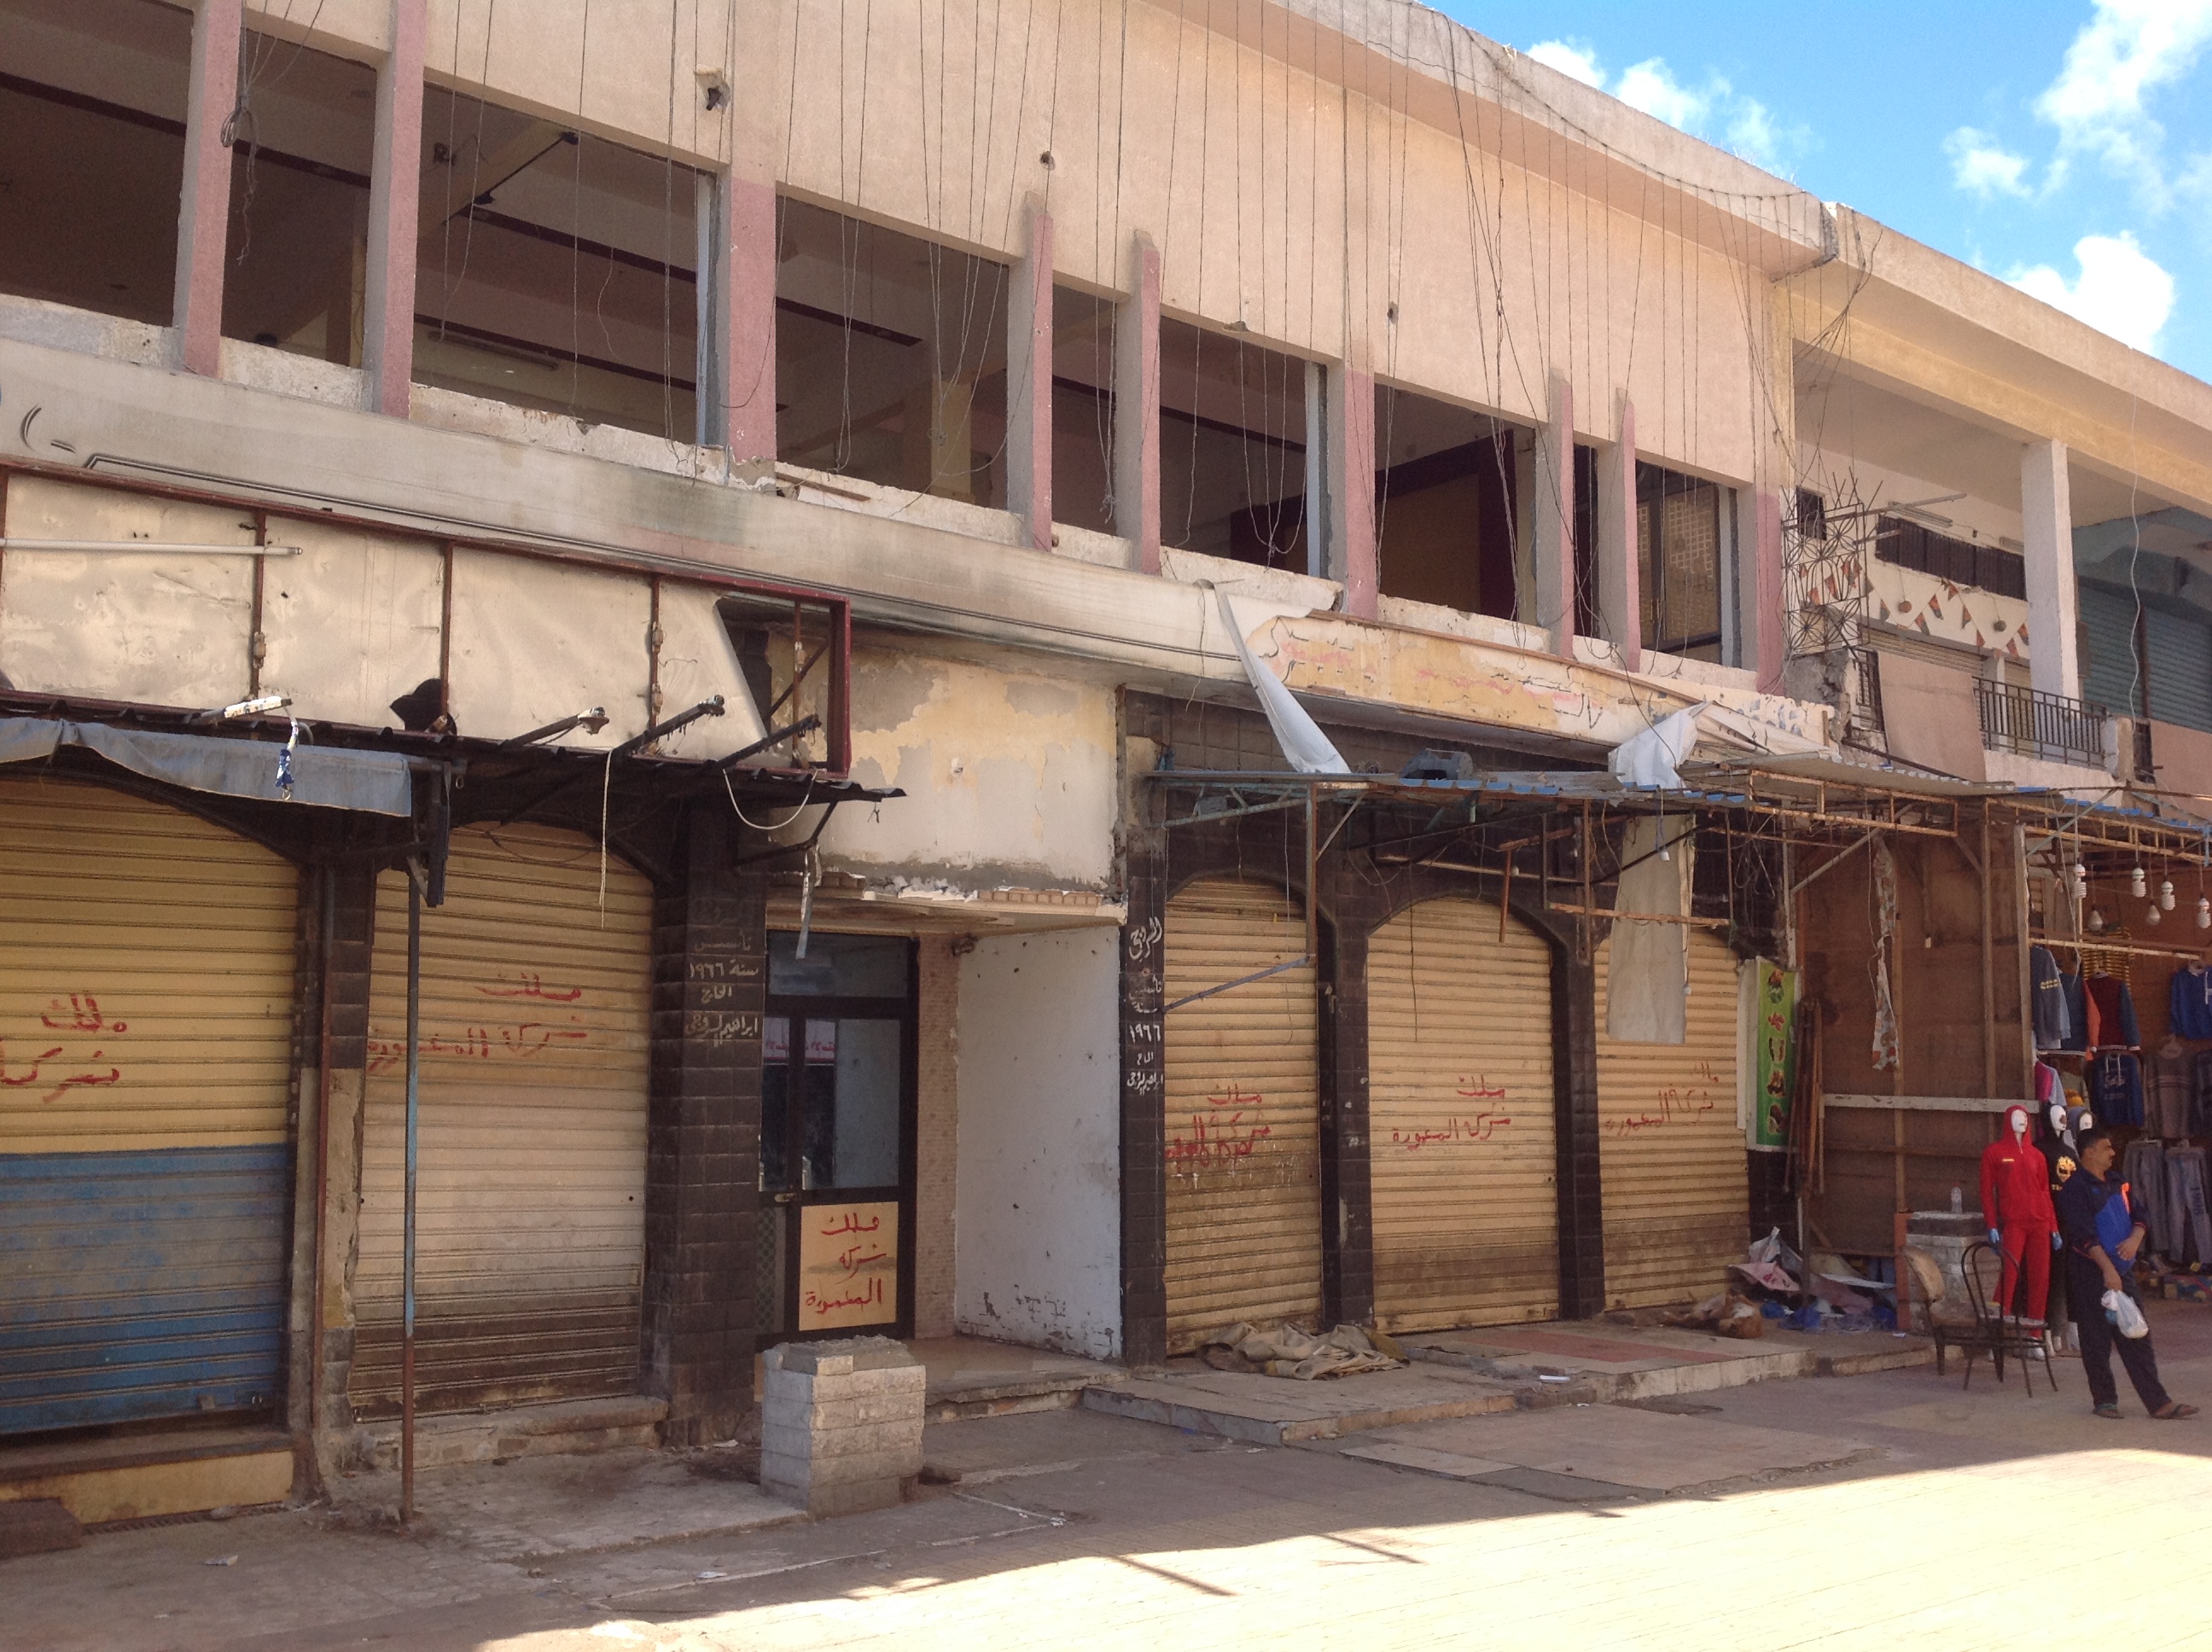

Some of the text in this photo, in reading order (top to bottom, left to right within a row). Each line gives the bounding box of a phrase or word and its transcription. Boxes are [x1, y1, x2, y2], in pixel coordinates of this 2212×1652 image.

[729, 958, 759, 976] سنة
[0, 1038, 120, 1103] شرك
[821, 1213, 880, 1236] ملك
